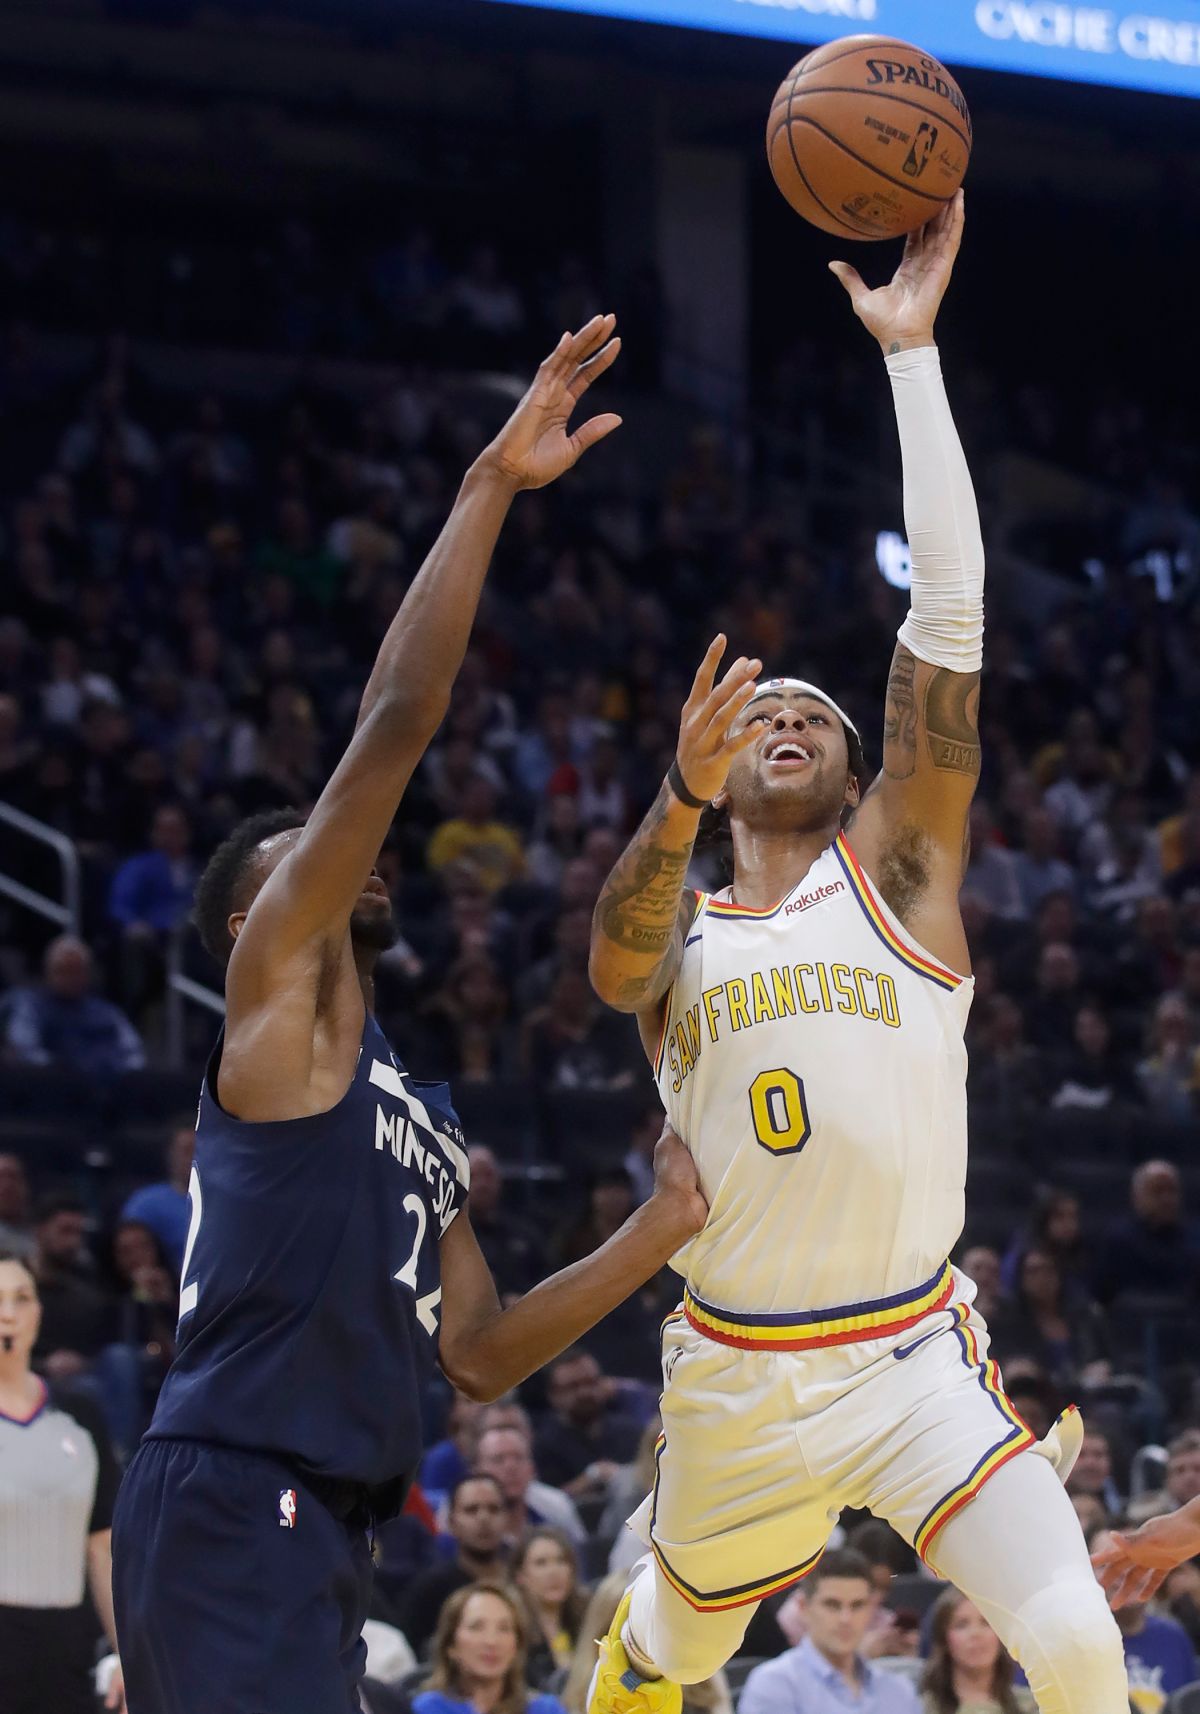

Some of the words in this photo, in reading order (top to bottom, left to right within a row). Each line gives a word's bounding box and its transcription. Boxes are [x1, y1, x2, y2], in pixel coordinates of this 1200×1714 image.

[1118, 14, 1200, 67] CRE
[784, 880, 845, 916] Rakuten
[667, 1003, 702, 1093] SAN
[702, 962, 901, 1043] FRANCISCO
[749, 1067, 812, 1157] 0
